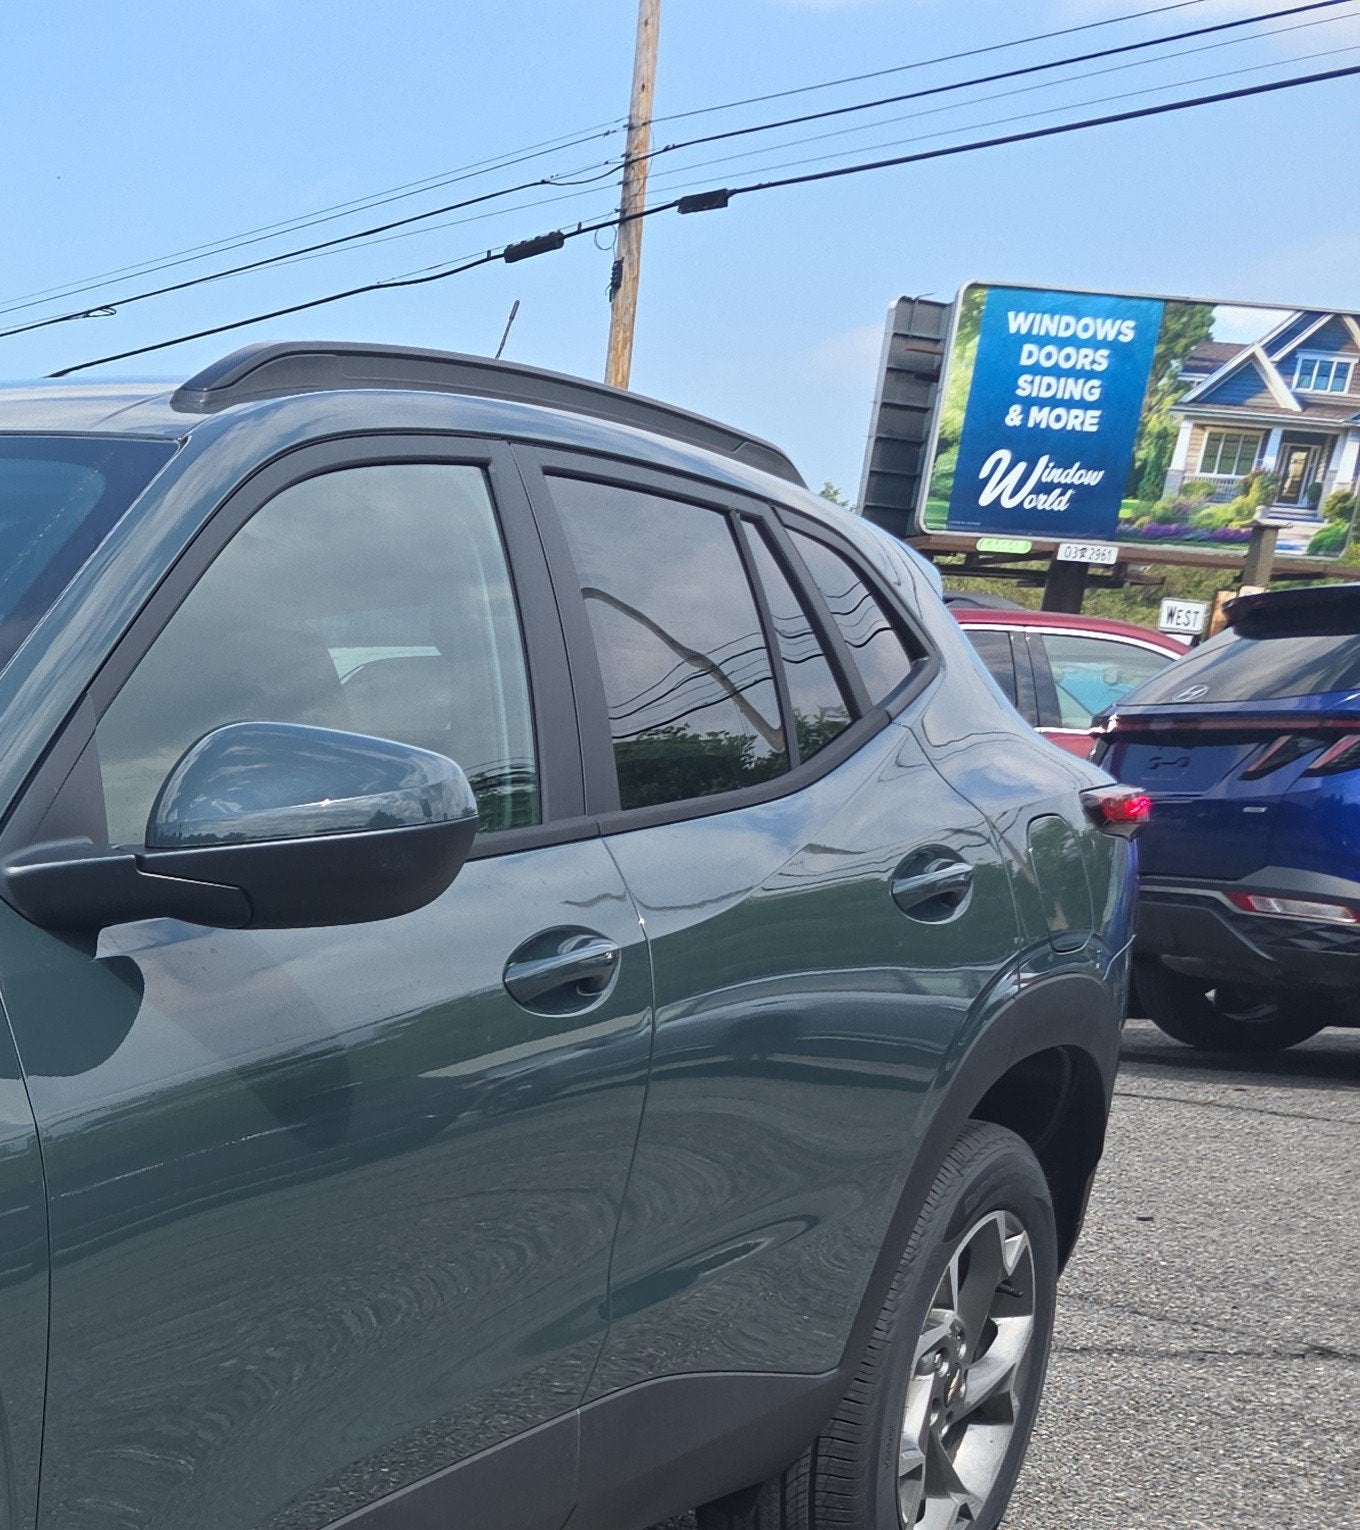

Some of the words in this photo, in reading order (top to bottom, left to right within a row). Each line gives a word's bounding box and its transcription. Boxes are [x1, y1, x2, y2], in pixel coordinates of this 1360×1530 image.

[1007, 310, 1137, 343] WINDOWS
[1019, 343, 1111, 372] DOORS
[1015, 374, 1103, 402] SIDING
[1004, 403, 1024, 427] &
[1027, 405, 1103, 433] MORE
[978, 449, 1106, 509] Window
[1166, 606, 1200, 627] WEST
